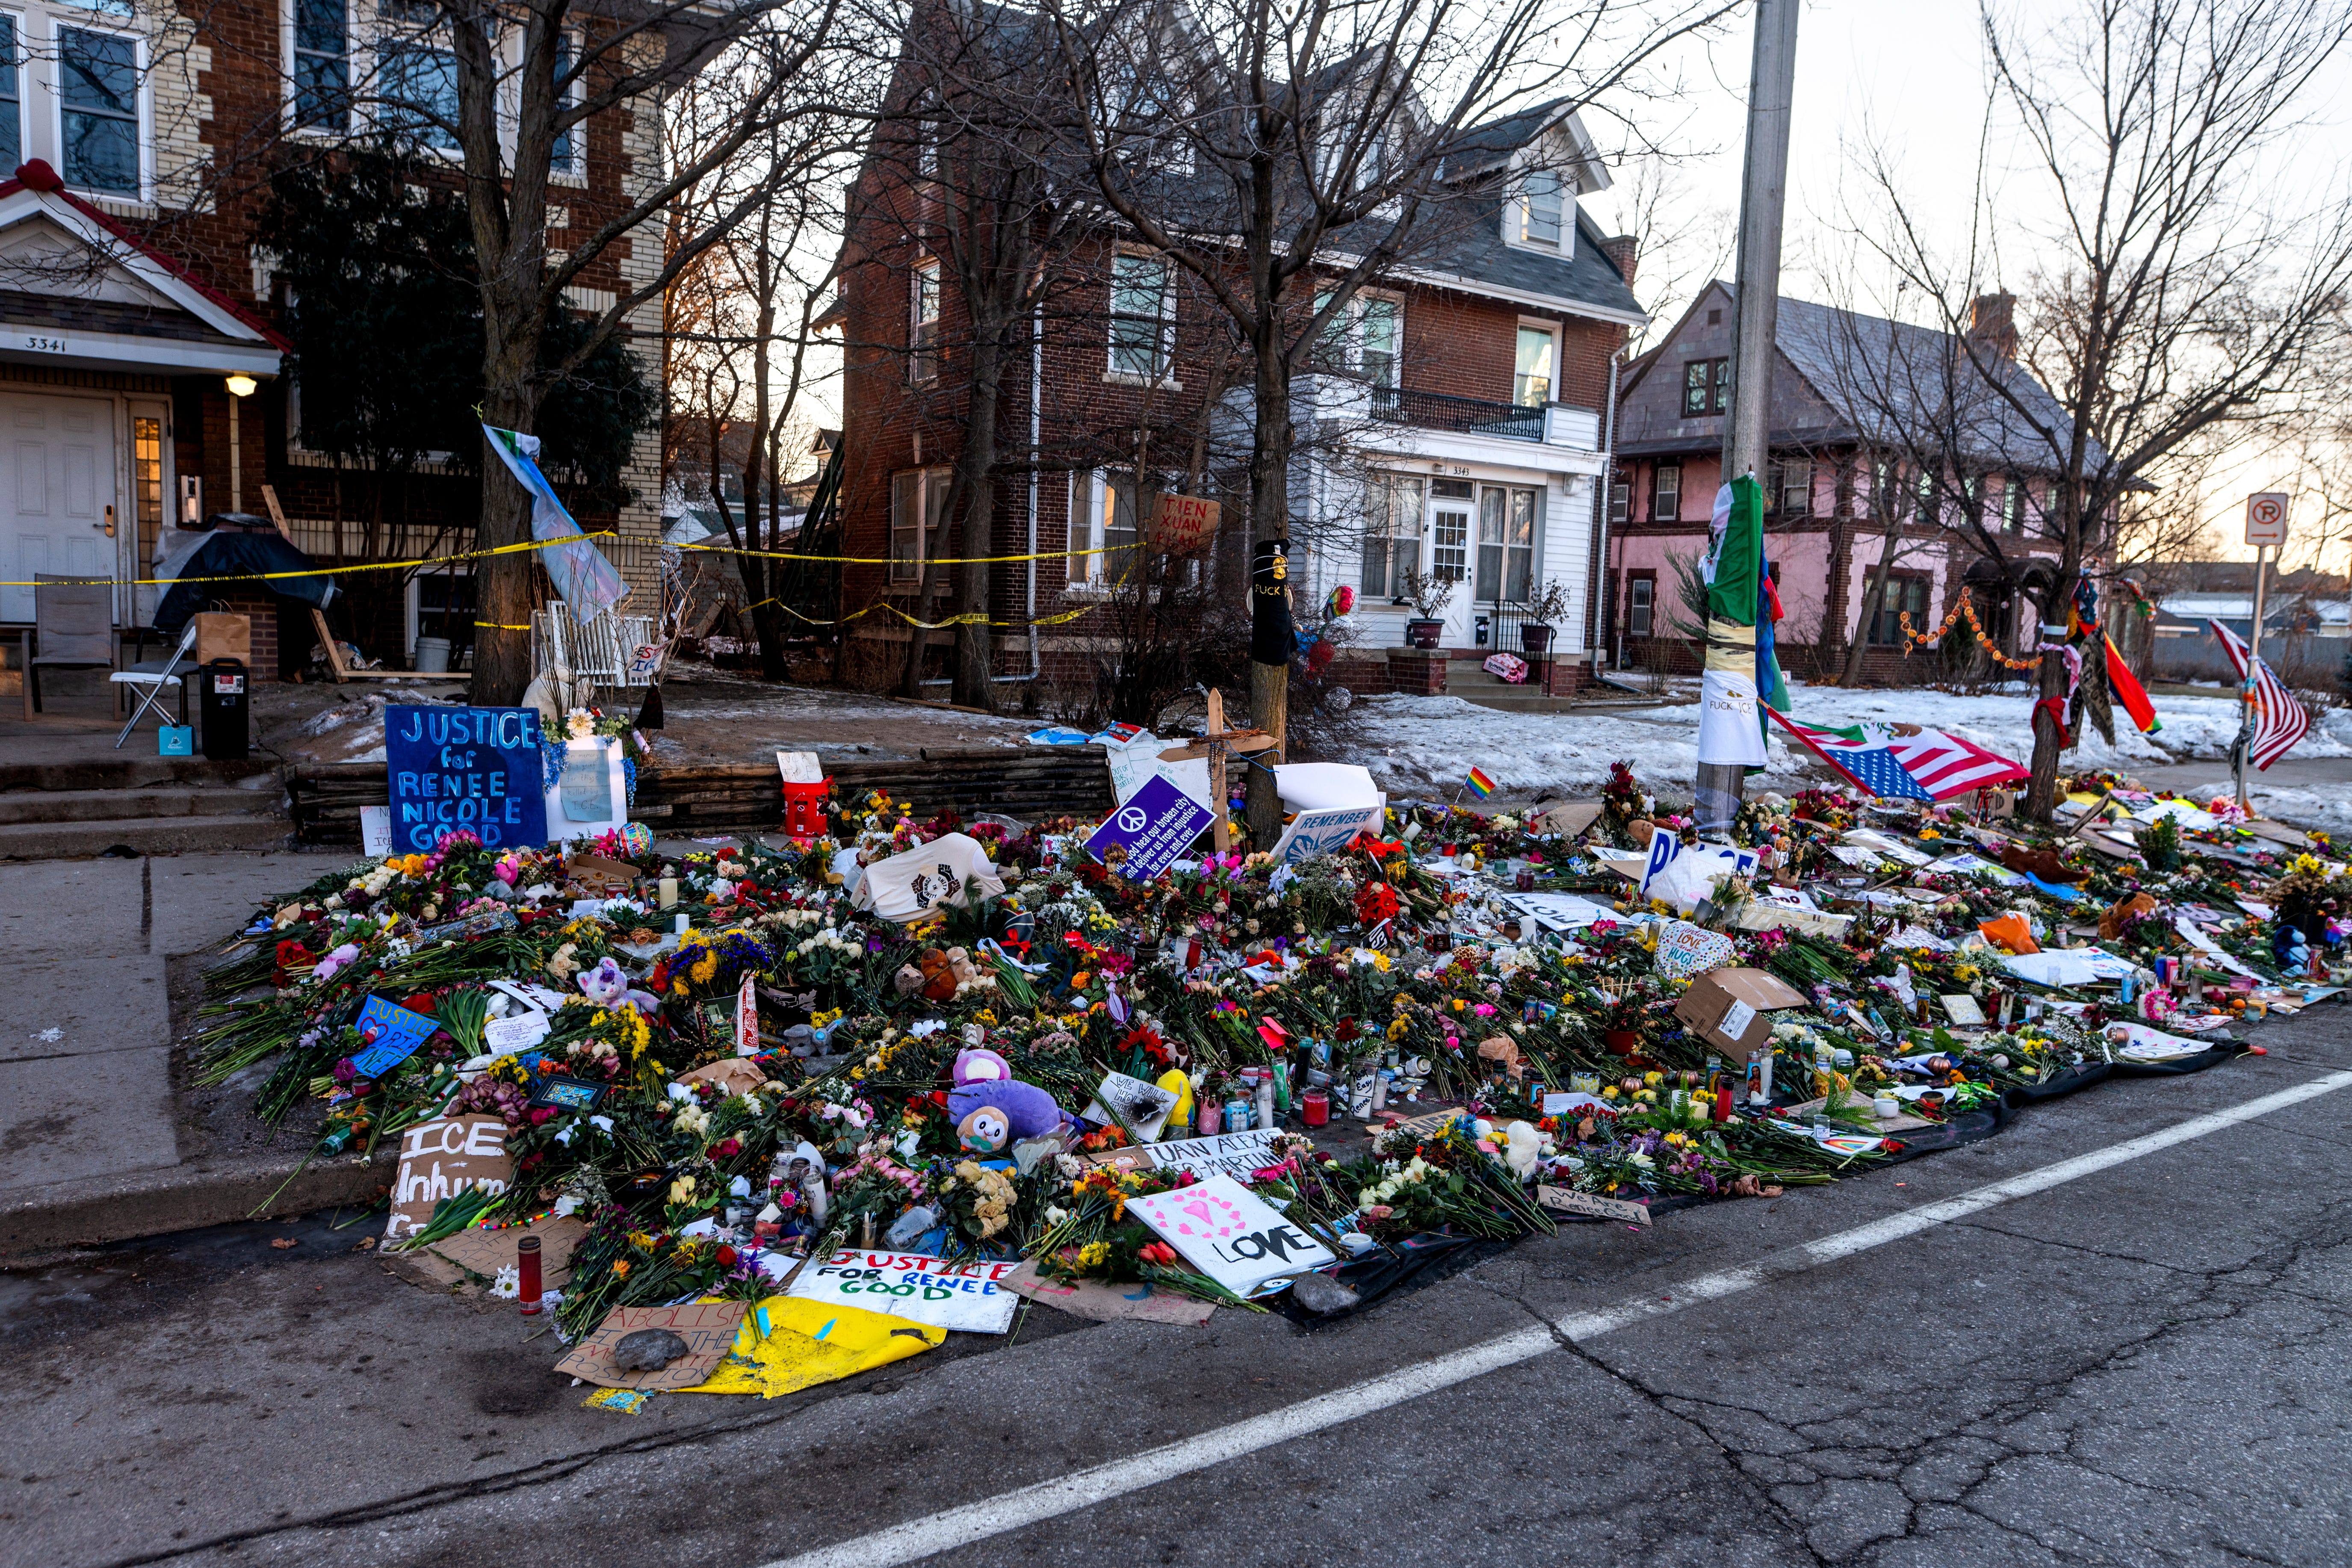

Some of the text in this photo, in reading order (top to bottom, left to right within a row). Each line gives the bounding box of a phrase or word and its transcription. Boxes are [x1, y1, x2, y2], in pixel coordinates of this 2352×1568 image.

[26, 337, 65, 353] 3341
[1454, 466, 1469, 476] 3343
[1164, 498, 1207, 518] TIEN
[1160, 514, 1201, 533] XUAN
[1256, 584, 1280, 595] FUCK
[1710, 701, 1752, 714] FUCK ICE
[401, 710, 537, 749] JUSTICE
[441, 746, 476, 769] for
[579, 753, 599, 761] memory
[781, 755, 807, 763] FUCK
[783, 765, 816, 782] ICE
[1112, 764, 1129, 776] OUT OF
[1114, 774, 1126, 783] OUR
[399, 771, 504, 797] RENEE
[1116, 777, 1134, 789] STATE!
[591, 788, 599, 799] by
[403, 797, 521, 823] NICOLE
[1175, 796, 1191, 810] city
[1154, 807, 1179, 828] broken
[1170, 806, 1199, 831] injustice
[1300, 811, 1371, 829] REMEMBER
[1148, 825, 1161, 837] our
[1157, 828, 1177, 844] from
[1133, 833, 1152, 850] heal
[1146, 827, 1195, 873] for ever and ever
[1153, 841, 1164, 850] us
[1135, 847, 1156, 868] deliver
[924, 877, 937, 899] COMMUNITY
[938, 876, 947, 891] UNITY
[1677, 933, 1701, 949] LOVE
[1668, 947, 1694, 965] HUGS
[368, 998, 439, 1038] JUSTICE
[1351, 1067, 1368, 1083] Rest
[1117, 1076, 1167, 1103] WE WILL
[1356, 1079, 1372, 1093] Easy
[1110, 1101, 1133, 1117] THE
[400, 1122, 508, 1160] ICE
[1143, 1131, 1280, 1162] UAN ALEXIS
[1550, 1188, 1627, 1211] We Are
[1550, 1196, 1643, 1223] Renee Good
[1212, 1225, 1317, 1264] LOVE
[830, 1252, 1015, 1280] JUSTICE
[839, 1280, 953, 1300] GOOD
[902, 1272, 999, 1295] RENEE
[603, 1302, 750, 1328] ABOLISH
[690, 1329, 739, 1350] THE
